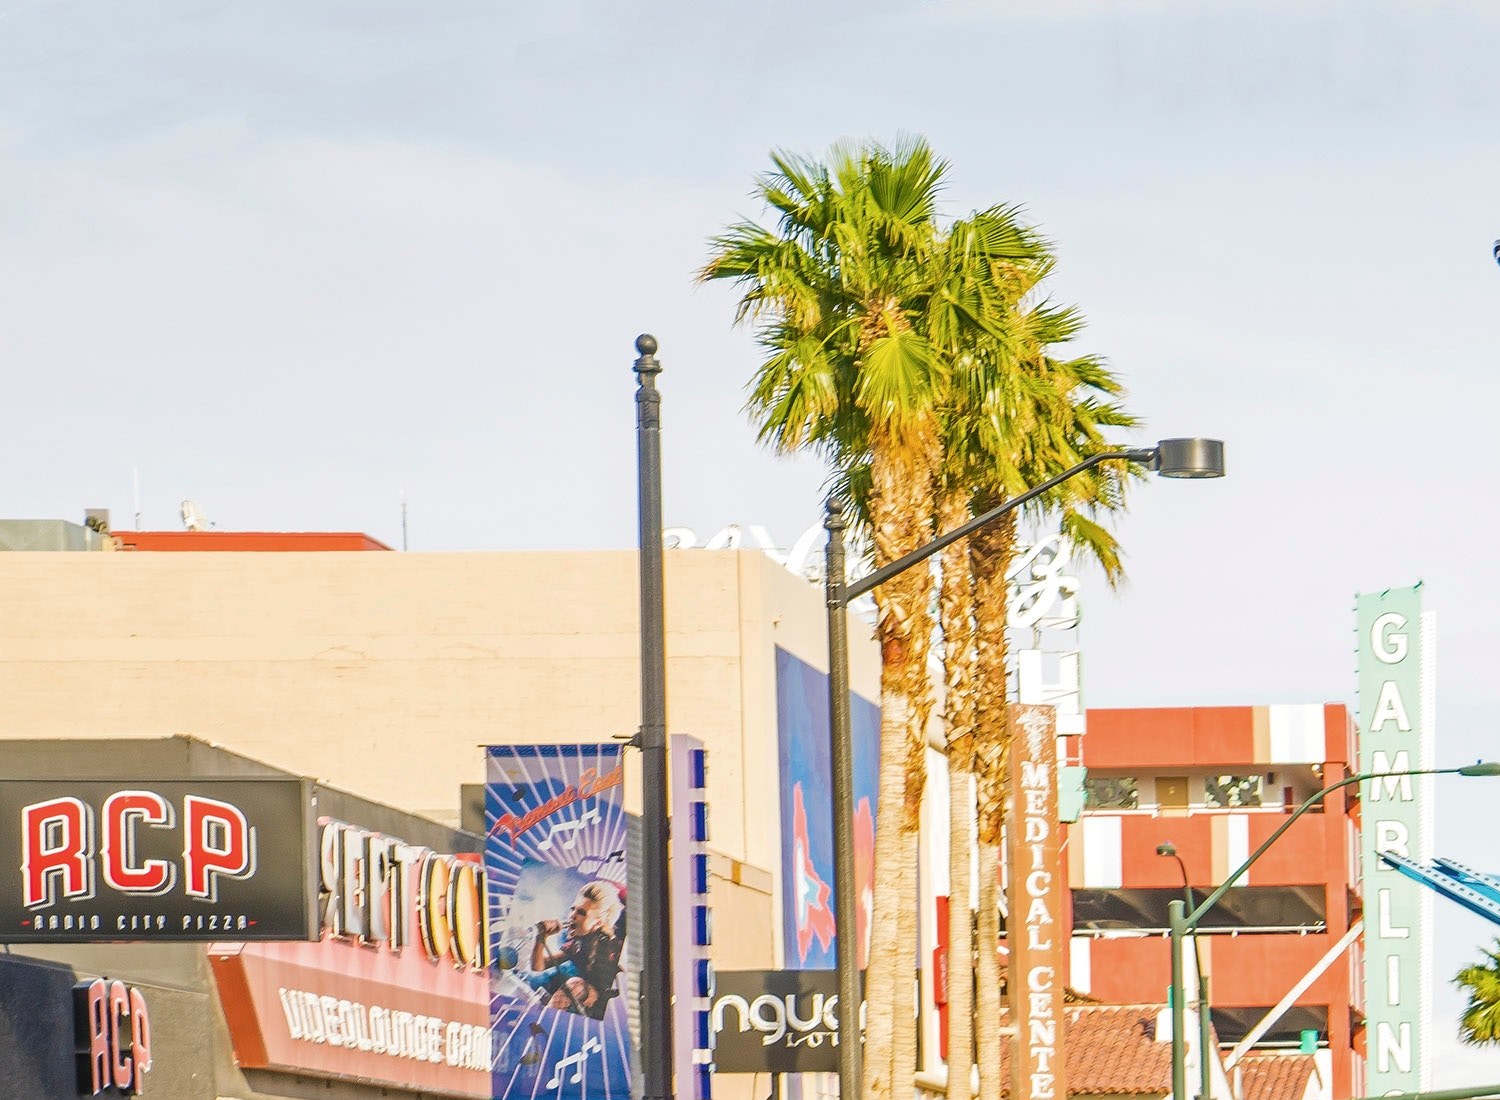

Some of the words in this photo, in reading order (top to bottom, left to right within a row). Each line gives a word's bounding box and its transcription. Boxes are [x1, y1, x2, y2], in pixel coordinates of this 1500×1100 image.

[20, 790, 256, 910] RCP
[1018, 760, 1053, 952] MEDICAL
[34, 914, 100, 931] RADIO
[117, 914, 167, 931] CITY
[182, 914, 249, 931] PIZZA
[87, 977, 153, 1097] RCP
